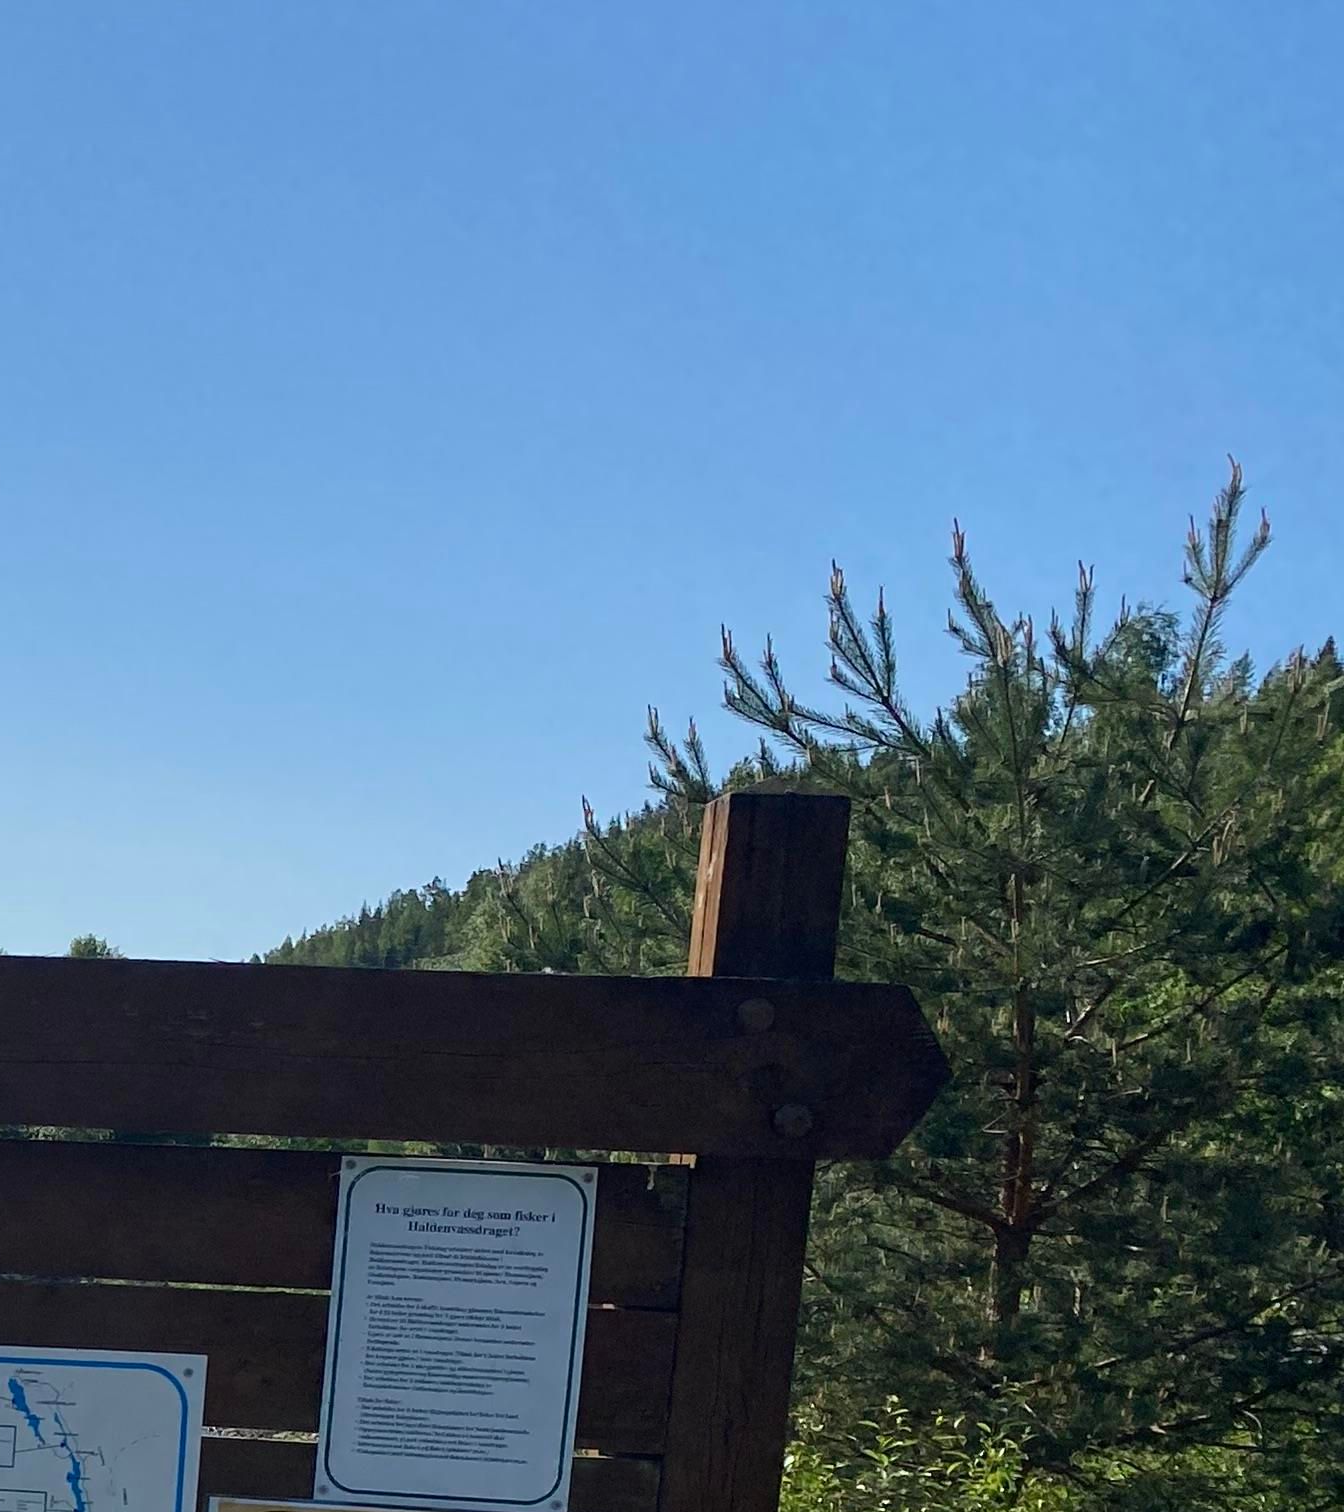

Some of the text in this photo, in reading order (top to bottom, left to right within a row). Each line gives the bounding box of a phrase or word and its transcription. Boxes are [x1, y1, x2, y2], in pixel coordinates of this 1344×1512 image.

[375, 1202, 399, 1214] Hva
[402, 1206, 439, 1218] gjøres
[442, 1206, 459, 1217] for
[462, 1208, 484, 1220] deg
[487, 1212, 511, 1220] som
[514, 1210, 548, 1222] fisker
[407, 1220, 520, 1239] Haldenvassdraget?
